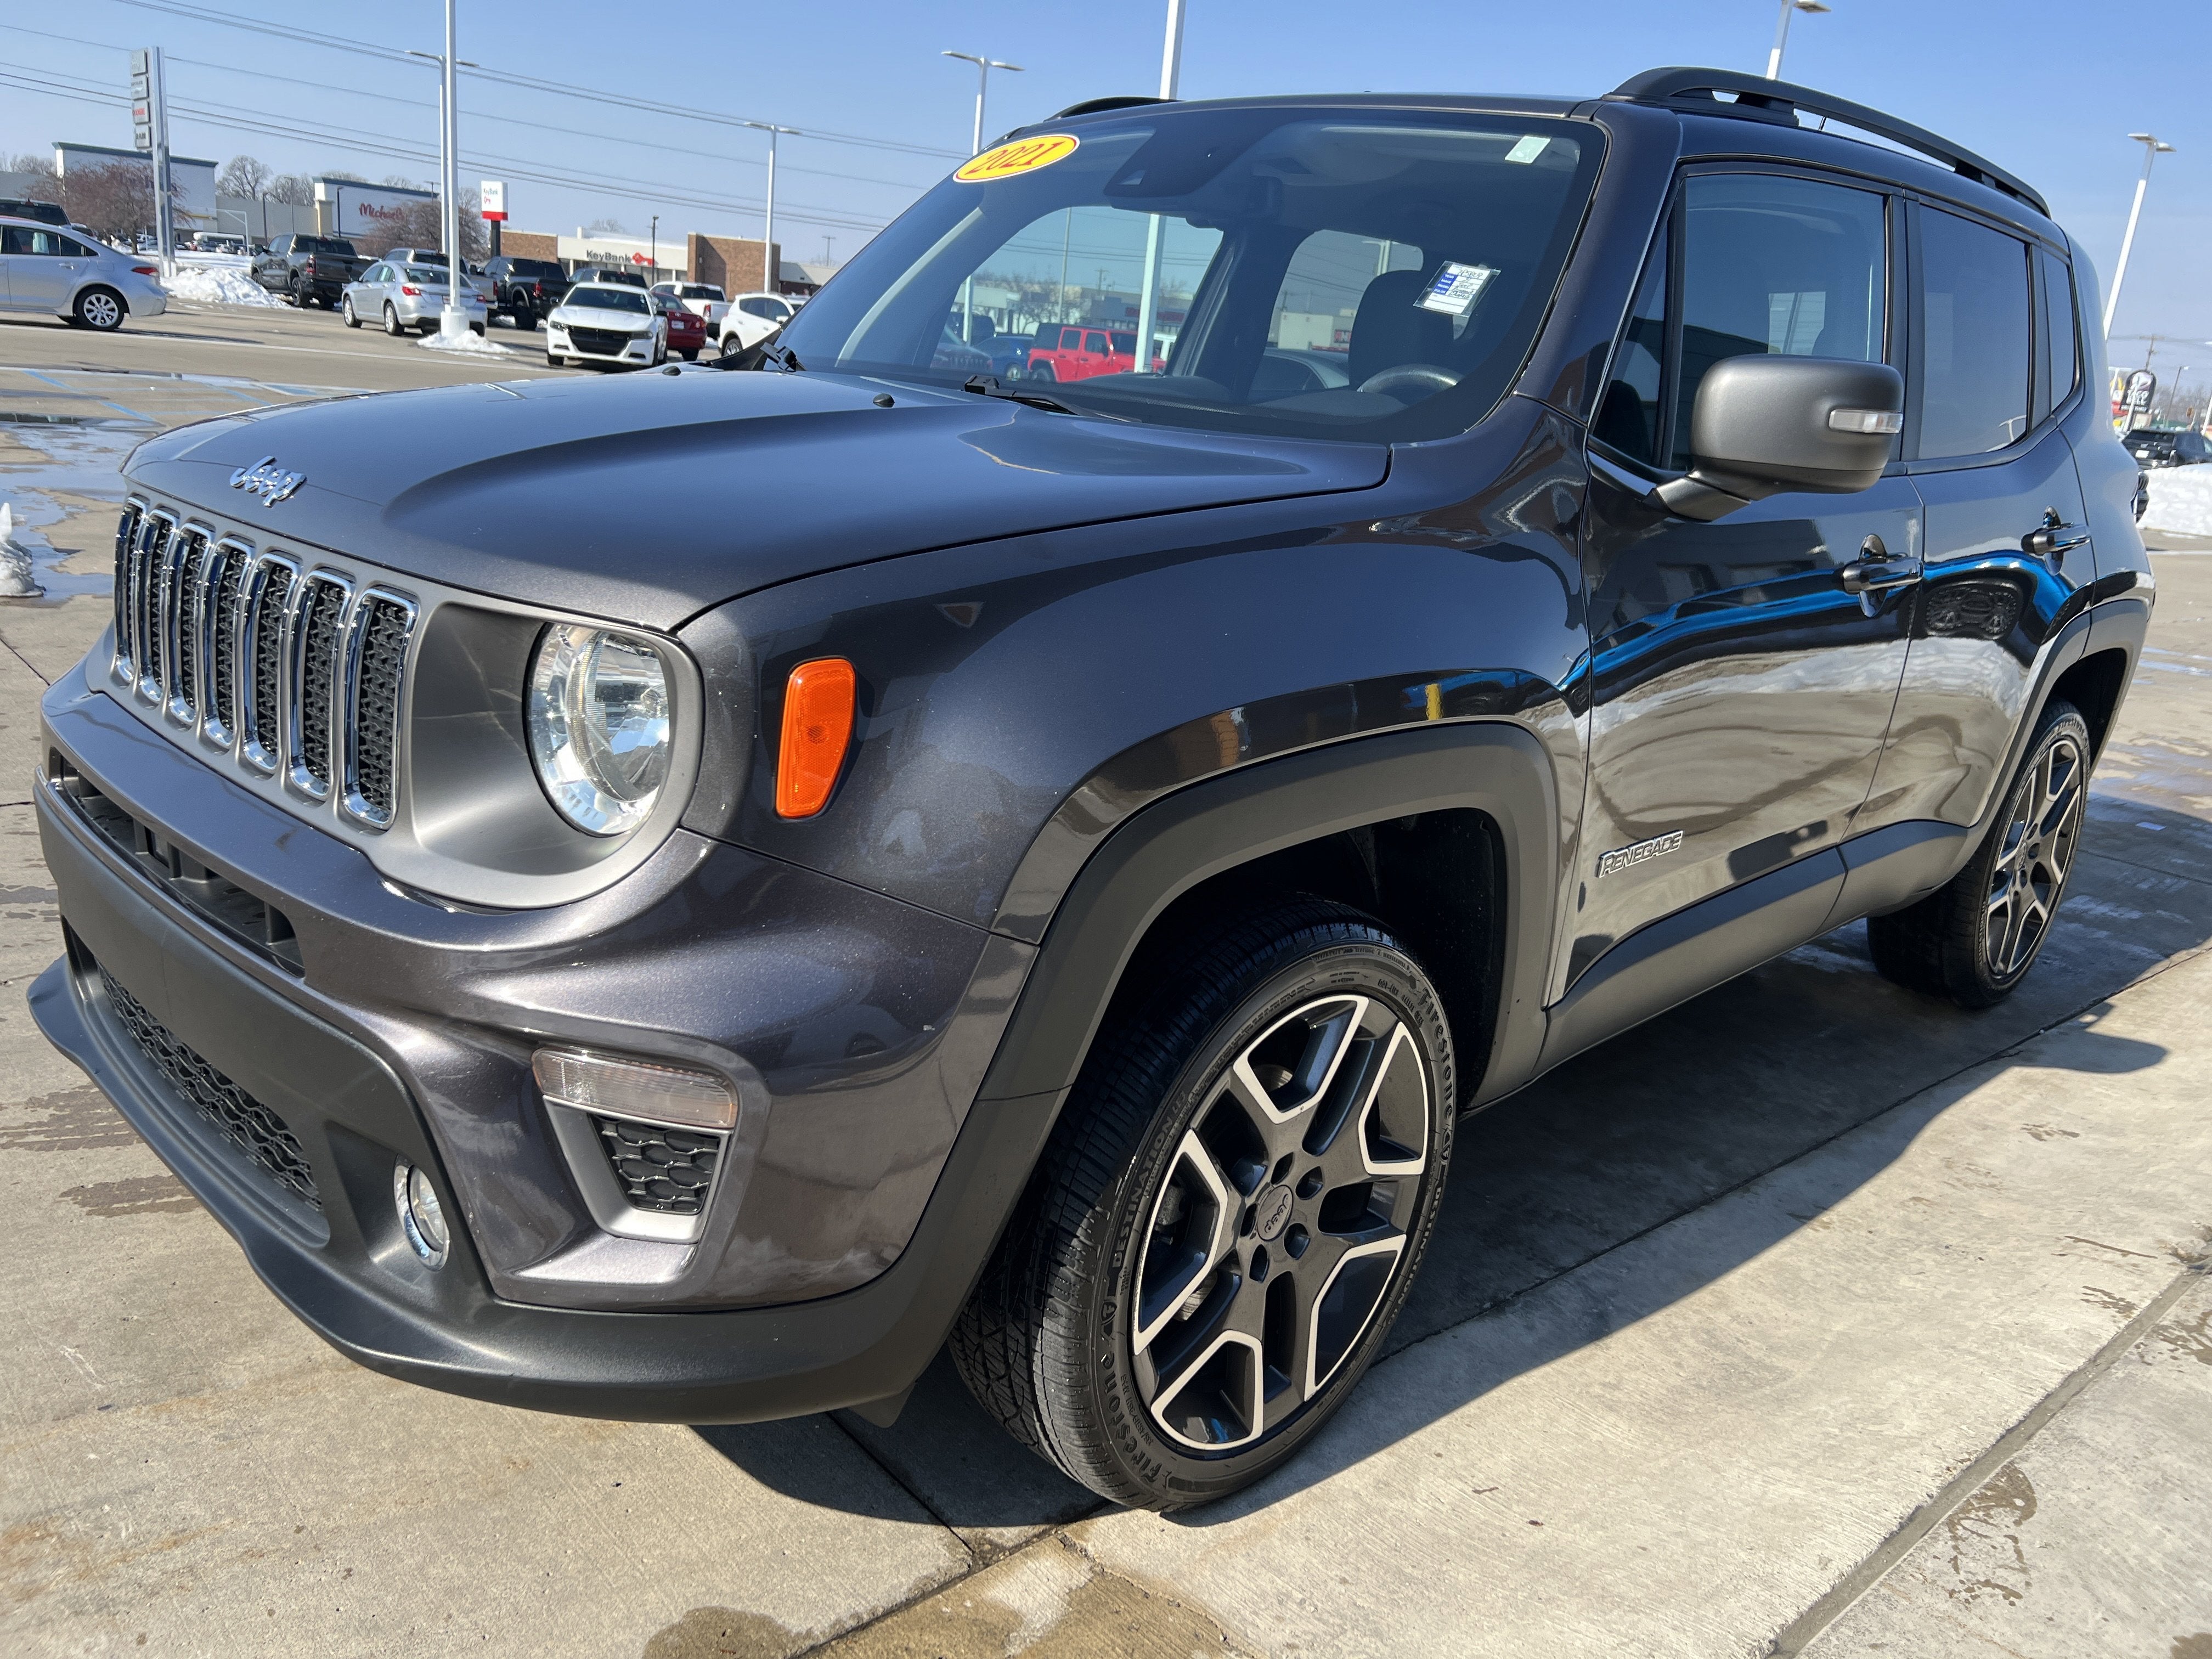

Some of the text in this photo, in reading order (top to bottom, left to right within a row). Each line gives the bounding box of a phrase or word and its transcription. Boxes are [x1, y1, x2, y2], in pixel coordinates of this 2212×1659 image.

[964, 141, 1065, 175] 2021
[586, 250, 632, 263] KeyBank
[229, 455, 307, 508] Jeep
[1596, 830, 1684, 878] RENEGADE
[1415, 985, 1453, 1120] Firestone
[1110, 1115, 1173, 1268] DESTINATION
[1264, 1193, 1288, 1233] Jeep
[1100, 1346, 1164, 1487] Firestone
